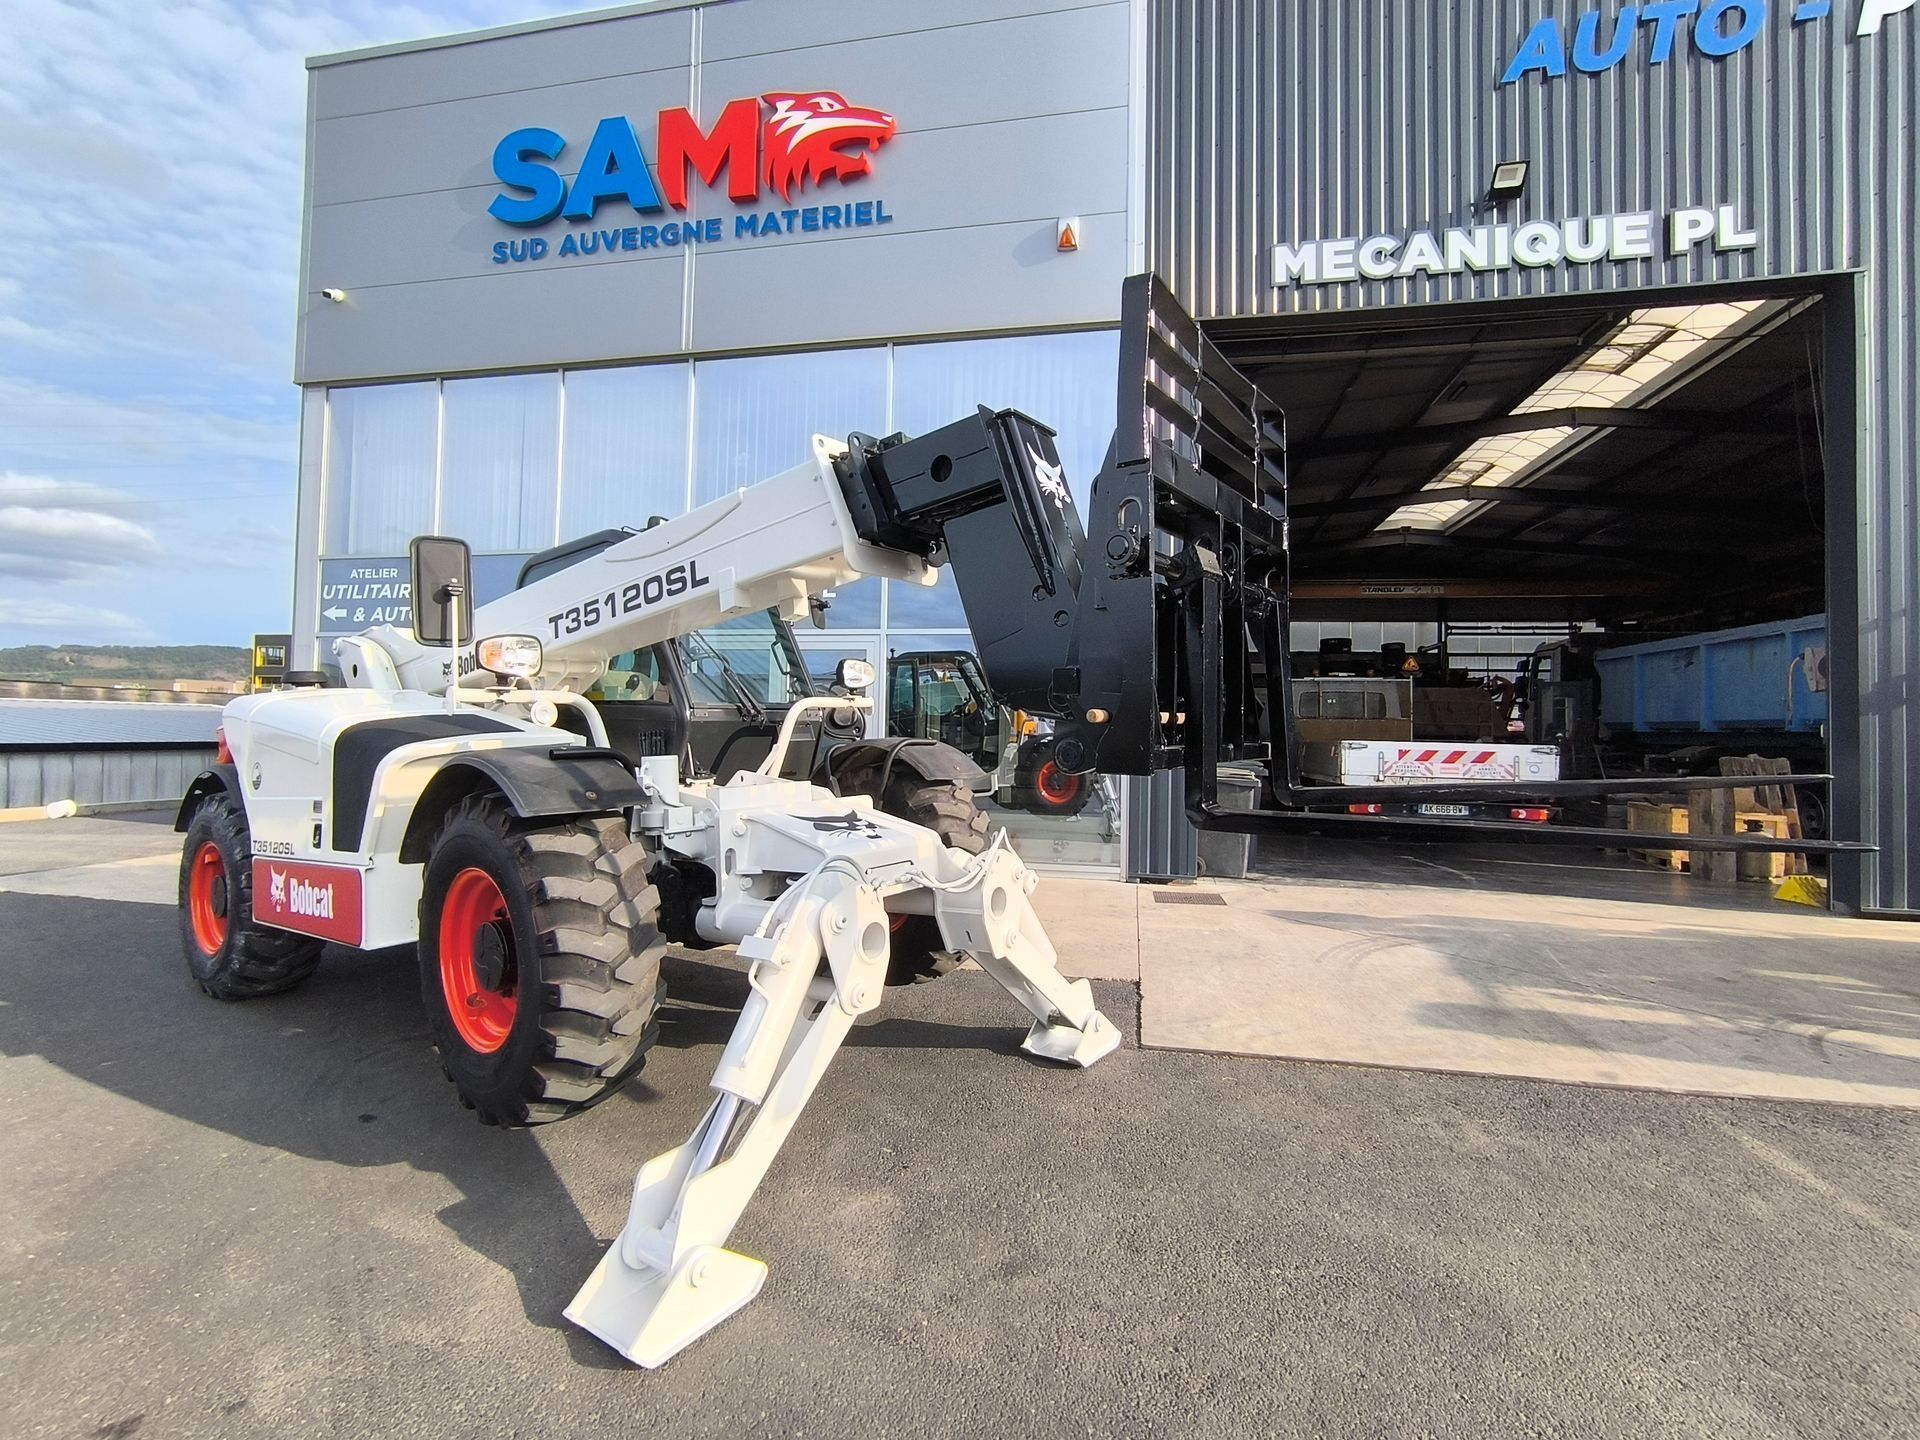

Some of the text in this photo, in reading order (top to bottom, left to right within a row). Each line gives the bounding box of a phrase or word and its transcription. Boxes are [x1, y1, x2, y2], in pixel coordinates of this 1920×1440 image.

[1500, 0, 1768, 83] AUTO
[487, 97, 762, 228] SAM
[492, 200, 893, 264] SUD AUVERGNE MATERIEL
[1272, 205, 1757, 285] MECANIQUE PL
[350, 568, 398, 579] ATELIER
[549, 560, 710, 639] T35120SL
[353, 607, 366, 622] &
[253, 840, 295, 855] T35120SL
[290, 878, 334, 919] Bobcat
